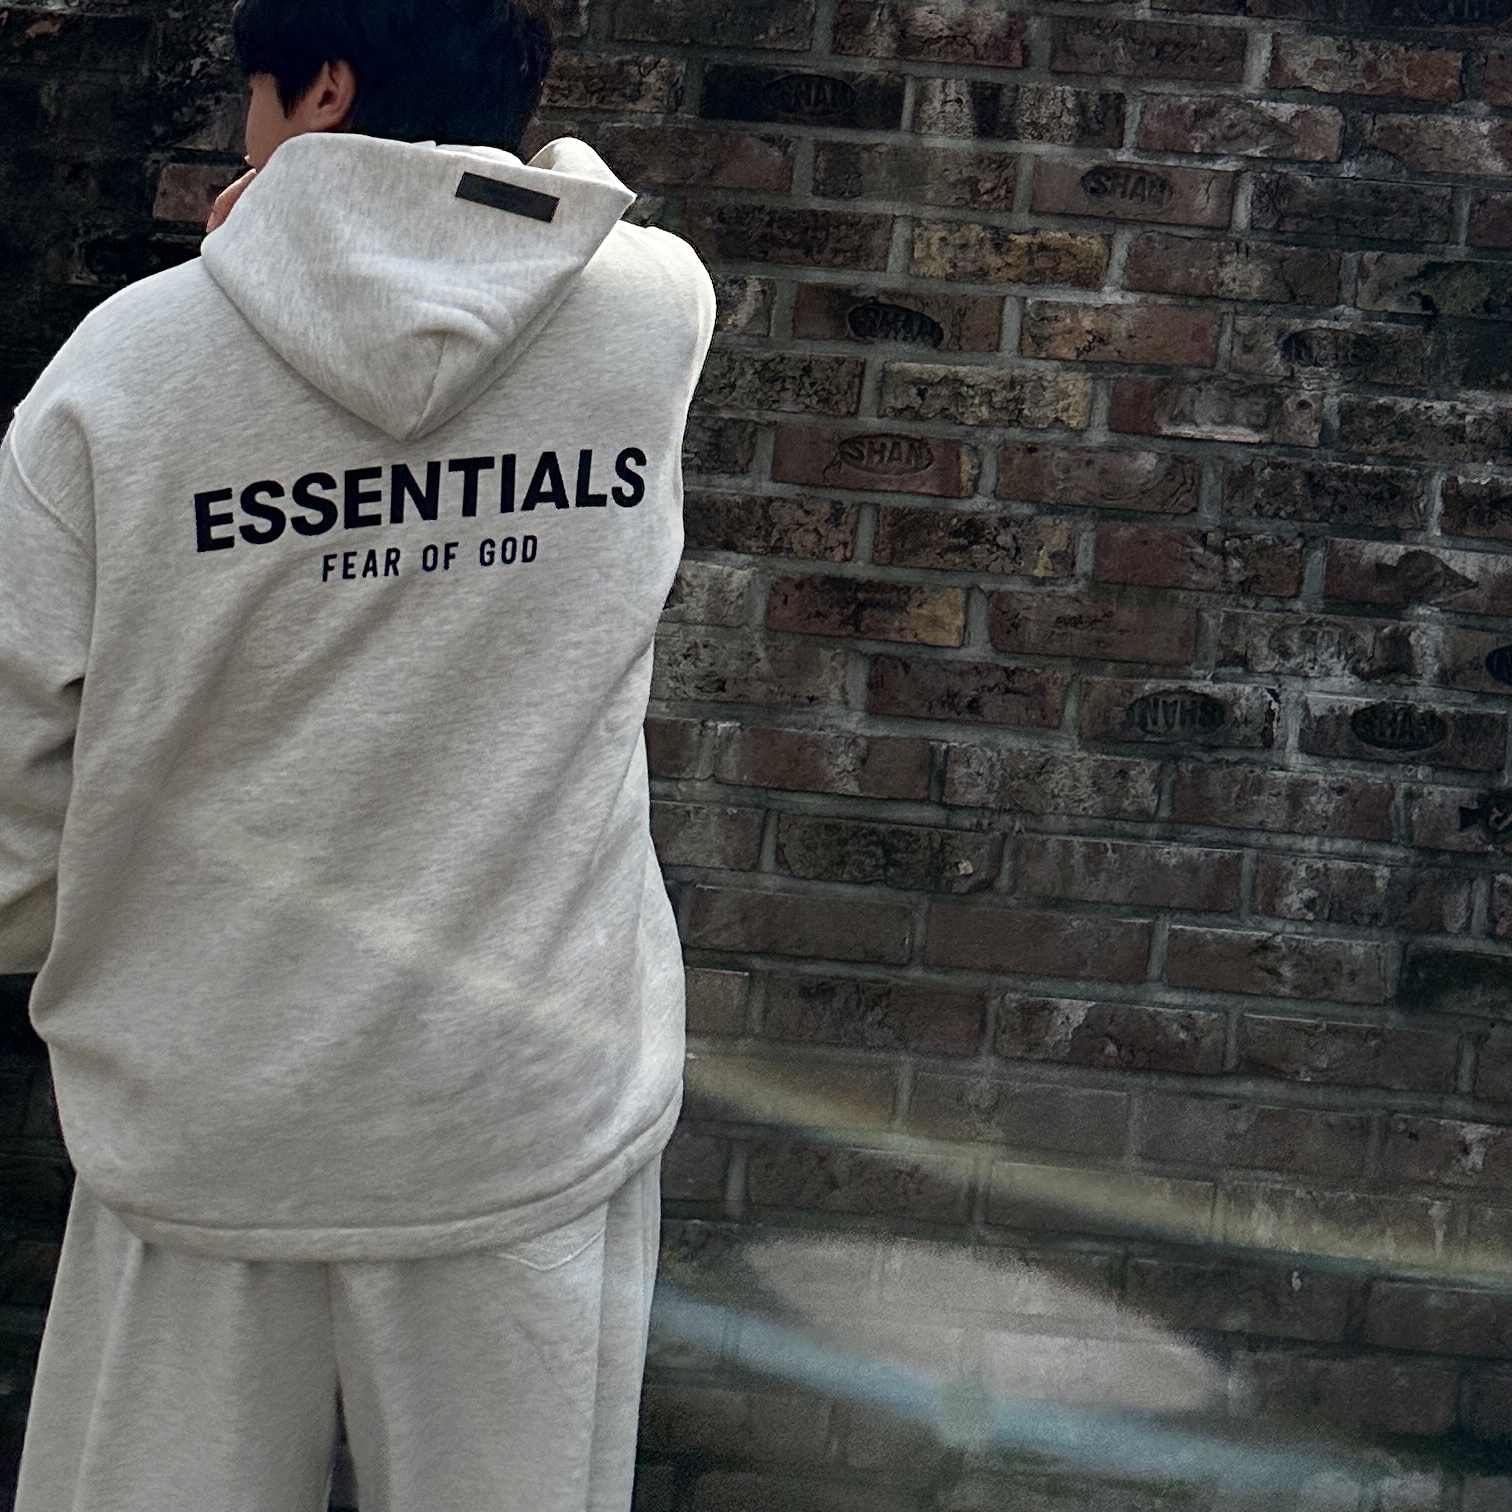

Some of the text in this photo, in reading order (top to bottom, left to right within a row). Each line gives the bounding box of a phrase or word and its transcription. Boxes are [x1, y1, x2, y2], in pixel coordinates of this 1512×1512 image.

[842, 438, 931, 470] SHAN
[193, 446, 647, 554] ESSENTIALS
[321, 534, 538, 583] FEAR OF GOD
